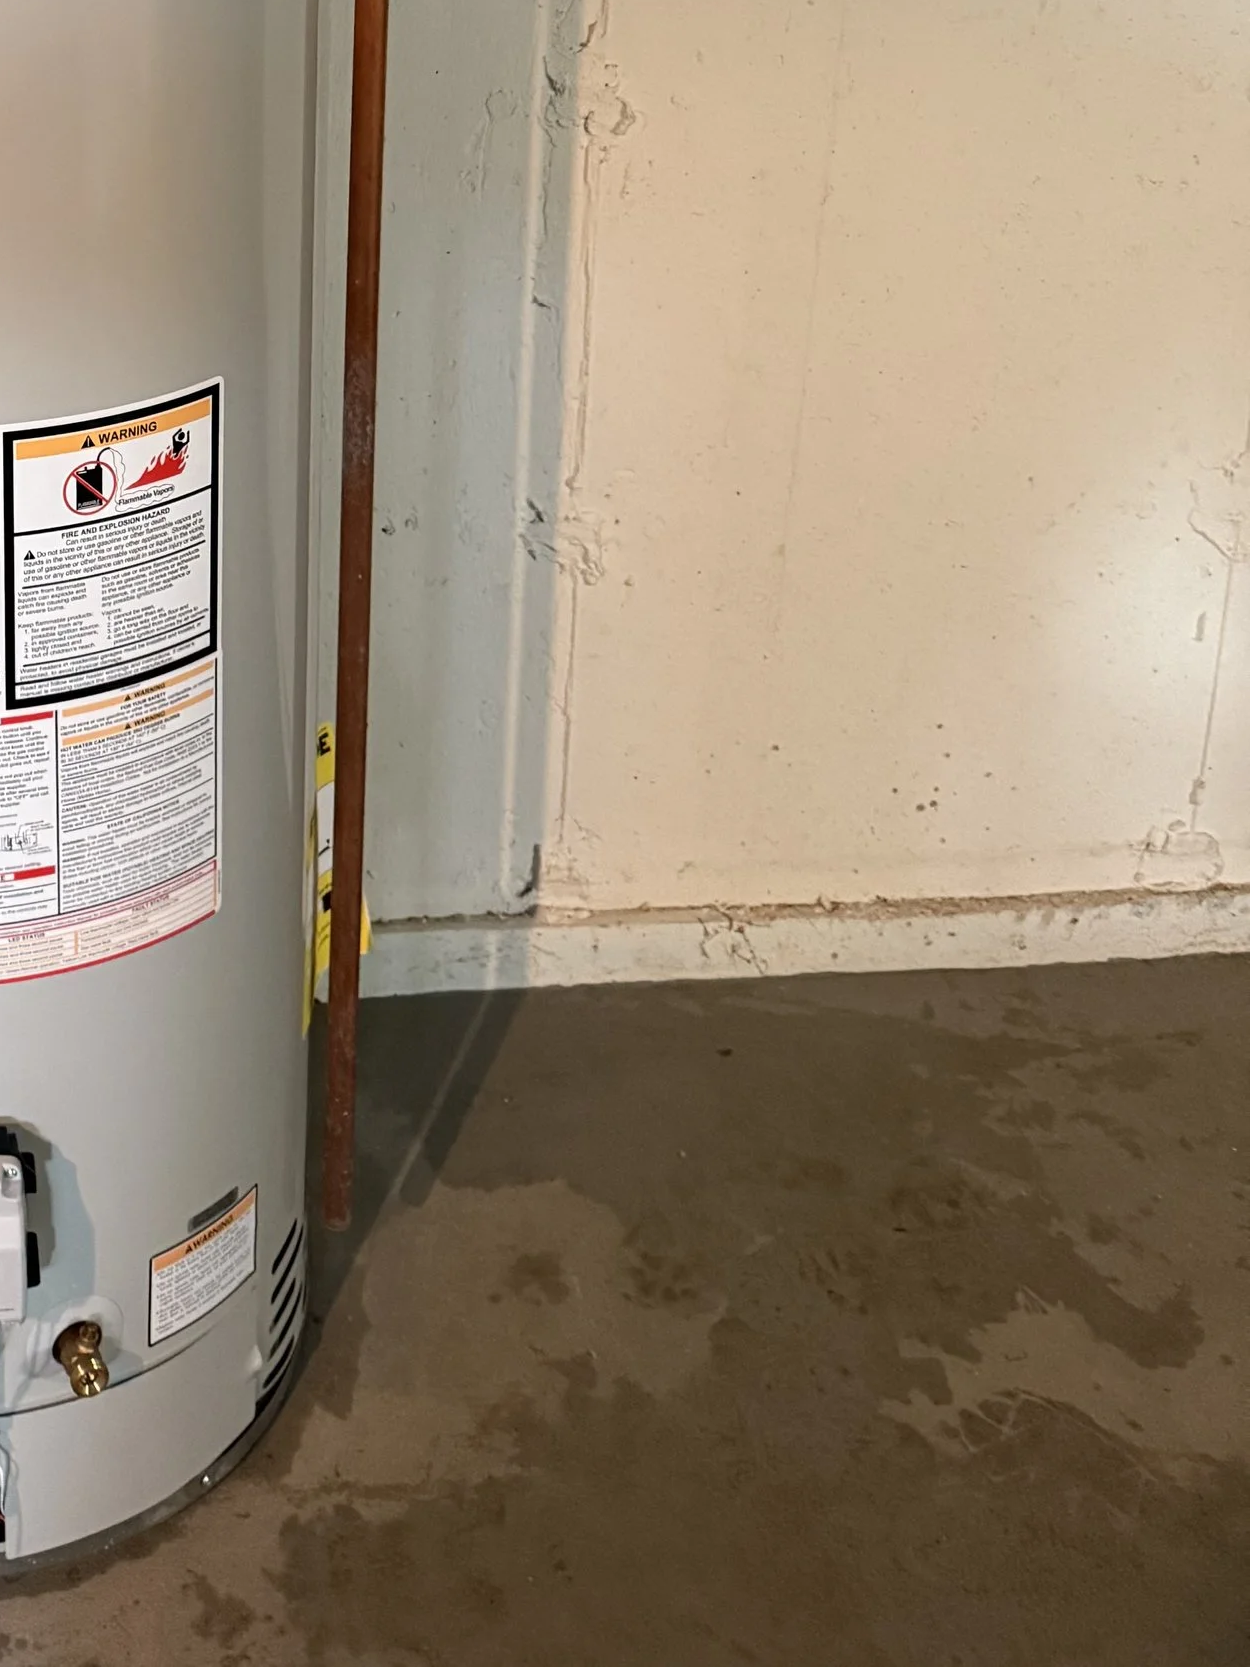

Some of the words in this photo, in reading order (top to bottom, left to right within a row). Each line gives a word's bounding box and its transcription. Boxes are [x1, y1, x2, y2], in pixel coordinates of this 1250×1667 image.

[99, 420, 157, 444] WARNING
[118, 492, 152, 505] Flammable
[154, 485, 174, 498] Vapors
[61, 530, 79, 539] FIRE
[81, 526, 97, 535] AND
[99, 515, 141, 531] EXPLOSION
[142, 507, 170, 520] HAZARD
[134, 682, 166, 698] WARNING
[134, 710, 166, 726] WARNING
